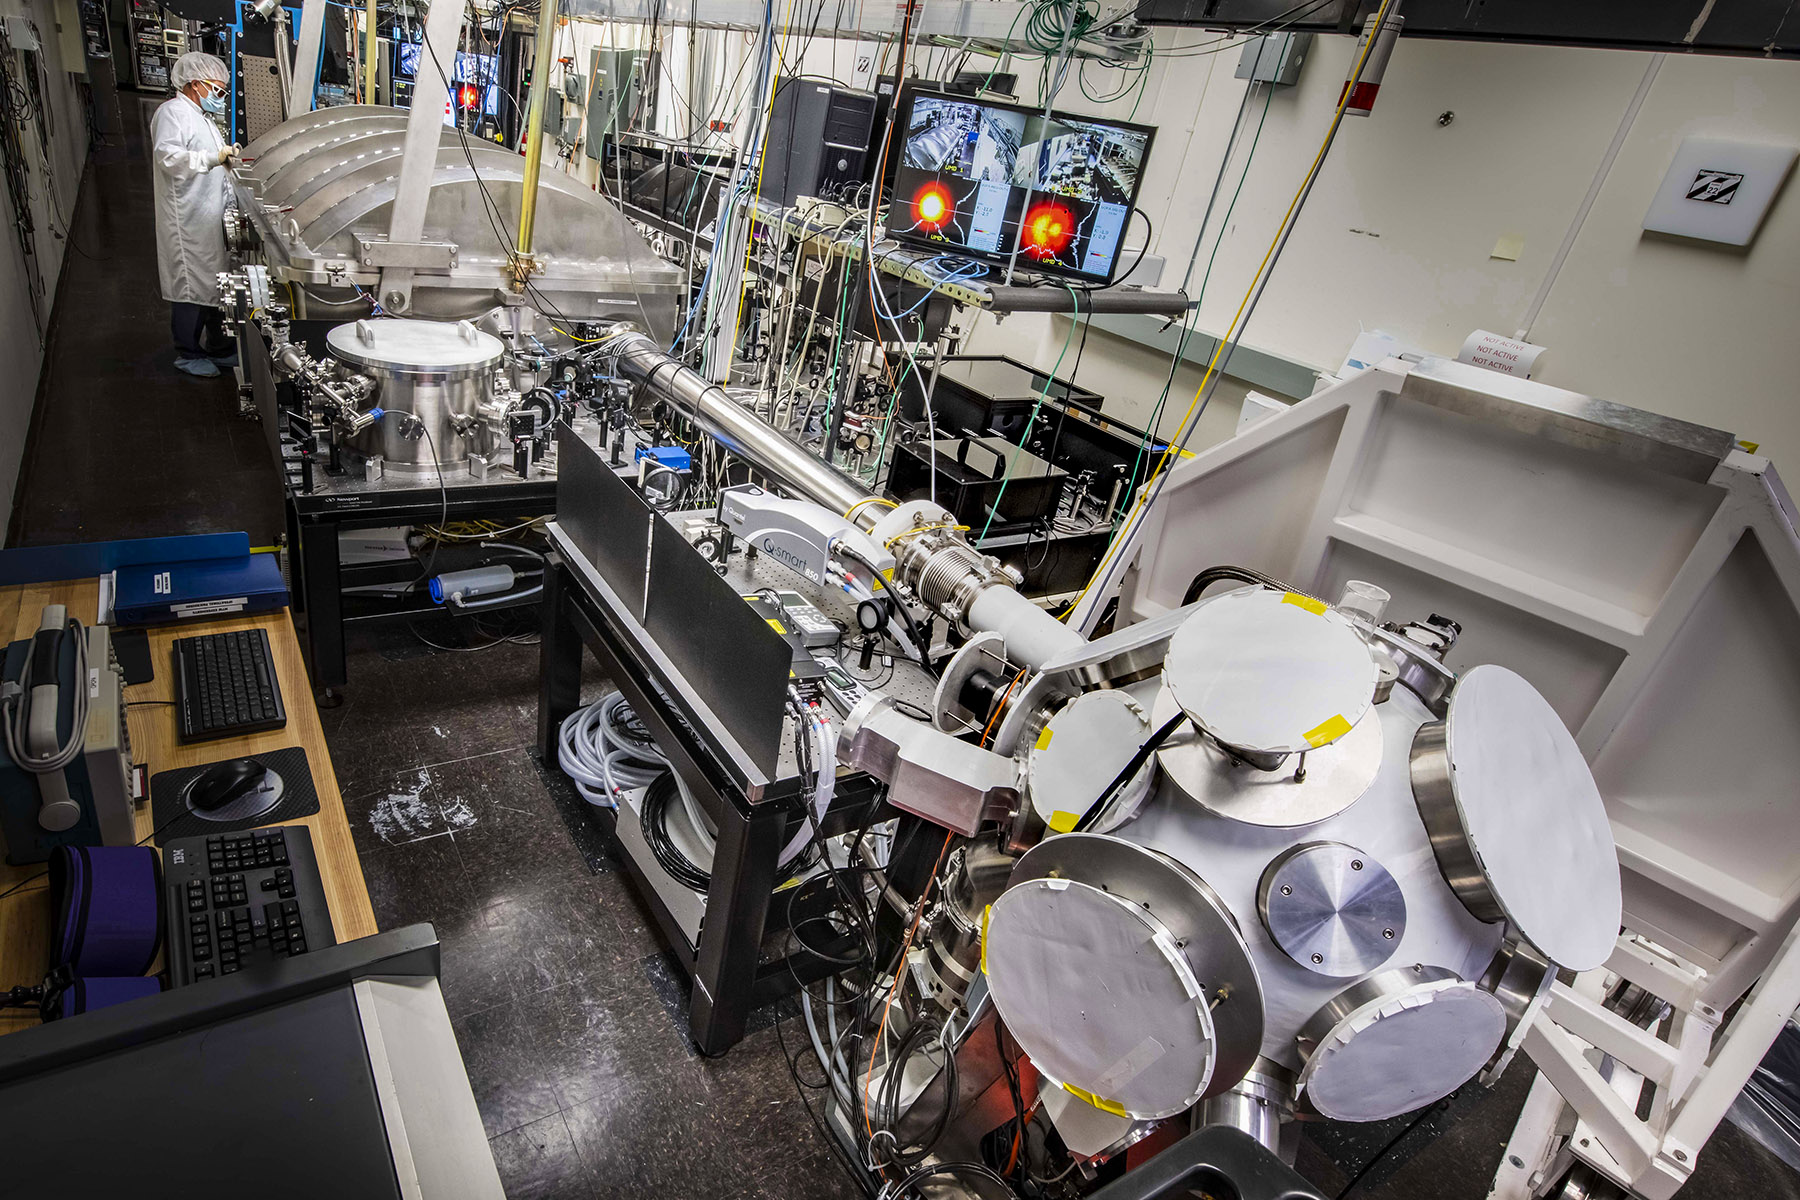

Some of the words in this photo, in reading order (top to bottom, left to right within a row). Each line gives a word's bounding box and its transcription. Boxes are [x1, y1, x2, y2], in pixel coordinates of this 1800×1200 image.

[1477, 345, 1493, 354] NOT
[1493, 350, 1518, 361] ACTIVE
[1500, 341, 1524, 351] ACTIVE
[1472, 356, 1488, 365] NOT
[1489, 361, 1513, 372] ACTIVE
[723, 504, 728, 512] by
[729, 506, 745, 520] Quantel
[805, 568, 819, 580] 850
[173, 849, 184, 864] IBM
